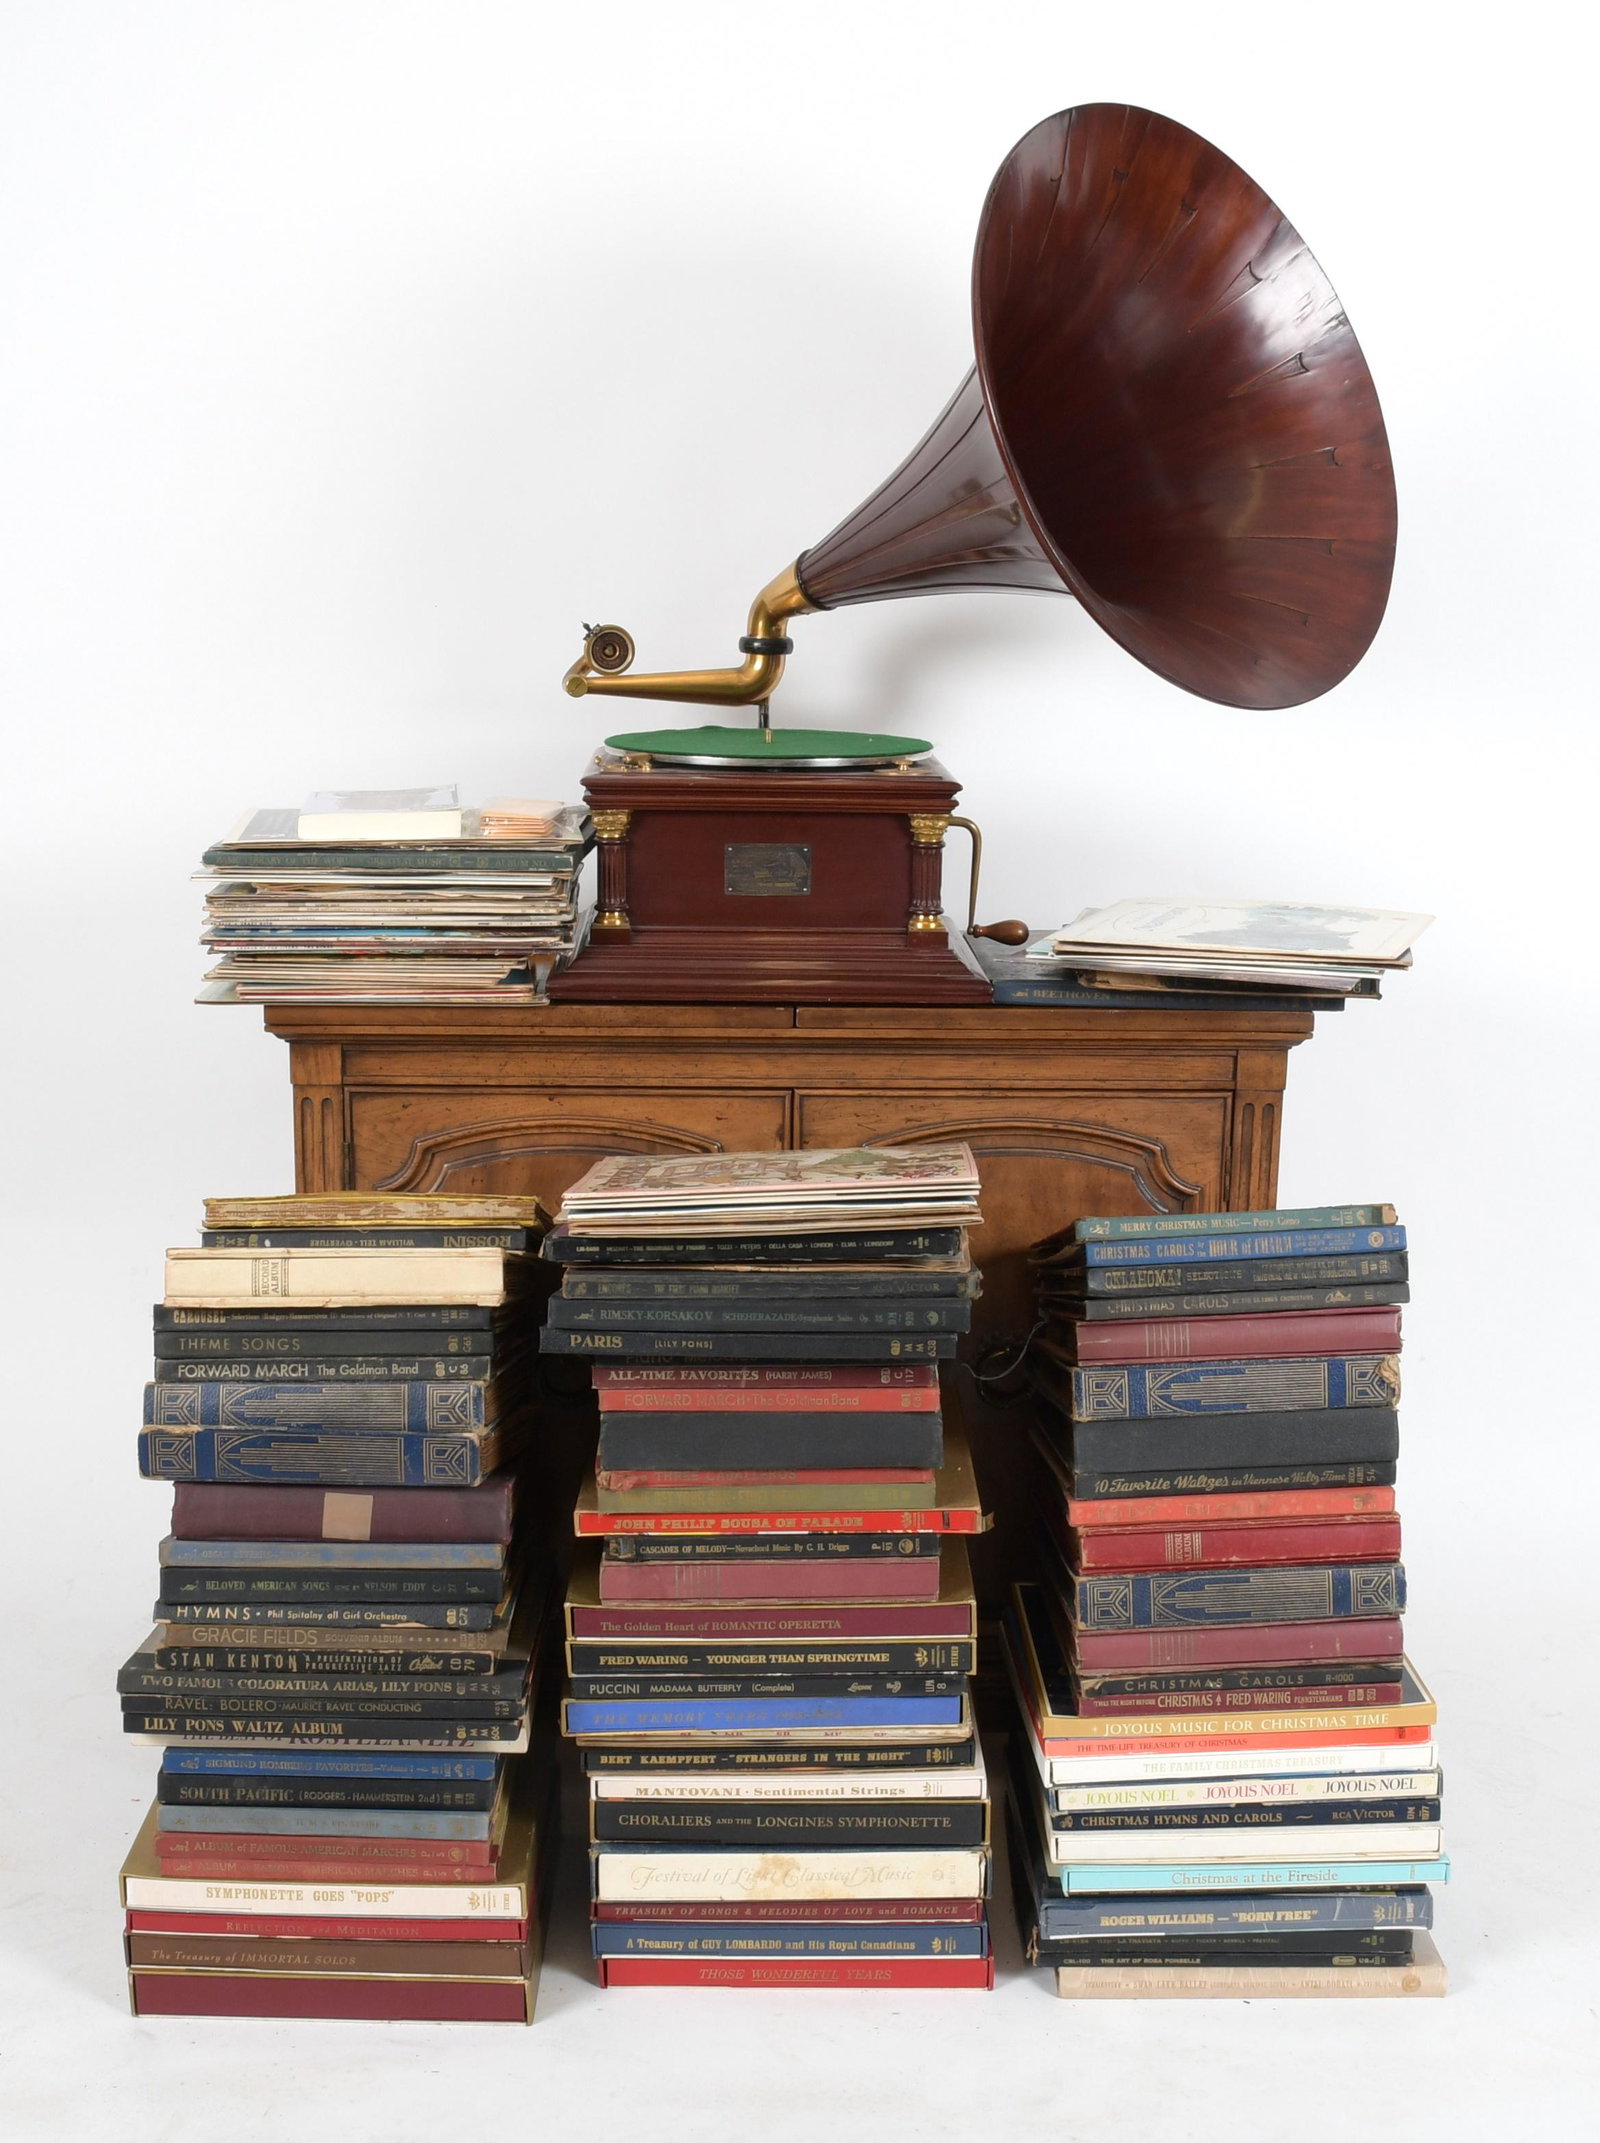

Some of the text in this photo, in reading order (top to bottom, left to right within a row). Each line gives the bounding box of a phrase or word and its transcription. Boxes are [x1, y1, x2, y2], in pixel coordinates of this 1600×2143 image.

[1120, 1219, 1206, 1232] MERRY CHRISTMAS
[443, 1235, 511, 1248] ROSSINI
[1094, 1244, 1194, 1259] CHRISTMAS CAROLS
[271, 1261, 279, 1293] ALBUM
[1105, 1269, 1181, 1290] OKLAHOMA!
[243, 1338, 300, 1350] SONGS
[570, 1334, 712, 1349] PARIS (LILY PONS)
[178, 1363, 418, 1377] FORWARD MARCH The Goldman Band
[608, 1370, 832, 1381] ALL-TIME FAVORITES (HARRY JAMES)
[1095, 1474, 1289, 1492] 10 Favorite Waltzes in Viennese
[615, 1517, 863, 1529] JOHN PHILIP SOUSA ON PARADE
[640, 1545, 692, 1554] CASCADES OF
[177, 1605, 407, 1621] HYMNS Phil Spitalny all Girl Orchestra
[601, 1620, 841, 1631] The Golden Heart of ROMANTIC OPERETTA
[192, 1629, 318, 1645] GRACIE FIELDS
[170, 1652, 297, 1670] STAN KENTON
[600, 1653, 889, 1665] FRED WARING YOUNGER THAN SPRINGTIME
[306, 1663, 373, 1671] PROGRESSIVE
[142, 1676, 452, 1692] TWO COLORATURA ARIAS, LILY PONS
[590, 1683, 794, 1694] PUCCINI MADAMA BUTTERFLY (Complete)
[1125, 1674, 1354, 1691] CHRISTMAS CAROLS R-1000
[220, 1697, 276, 1712] BOLERO
[282, 1703, 322, 1712] MAURICE
[326, 1703, 354, 1712] RAVEL
[358, 1704, 421, 1713] CONDUCTING
[1158, 1691, 1290, 1708] CHRISTMAS FRED WARING
[144, 1718, 343, 1735] LILY PONS WALTZ ALBUM
[1103, 1713, 1388, 1735] JOYOUS MUSIC FOR CHRISTMAS TIME
[1139, 1741, 1182, 1749] TREASURY
[1199, 1739, 1247, 1748] CHRISTMAS
[600, 1752, 910, 1763] BERT KAEMPFERT "STRANGERS IN THE NIGHT"
[1285, 1756, 1343, 1767] TREASURY
[180, 1786, 293, 1800] SOUTH PACIFIC
[636, 1786, 904, 1796] MANTOVANI Sentimental Strings
[1203, 1784, 1298, 1799] JOYOUS NOEL
[1322, 1779, 1416, 1793] JOYOUS NOEL
[1084, 1790, 1177, 1805] JOYOUS NOEL
[619, 1814, 711, 1827] CHORALIERS
[757, 1815, 833, 1827] LONGINES
[838, 1815, 951, 1828] SYMPHONETTE
[1082, 1810, 1395, 1826] CHRISTMAS HYMNS AND CAROLS RCA VICTOR
[1172, 1870, 1337, 1884] Christmas at the Fireside
[207, 1887, 395, 1903] SYMPHONETTE GOES "POPS"
[616, 1907, 674, 1916] TREASURY
[681, 1907, 694, 1916] OF
[702, 1906, 739, 1915] SONGS
[759, 1906, 816, 1915] MELODIES
[846, 1906, 872, 1915] LOVE
[879, 1906, 895, 1914] and
[1100, 1910, 1318, 1926] ROGER WILLIAMS "BORN FREE"
[627, 1939, 914, 1951] A Treasury of GUY LOMBARDO and His Royal Canadians
[152, 1951, 356, 1965] The Treasury of IMMORTAL SOLOS
[700, 1969, 891, 1980] THOSE WONDERFUL YEARS
